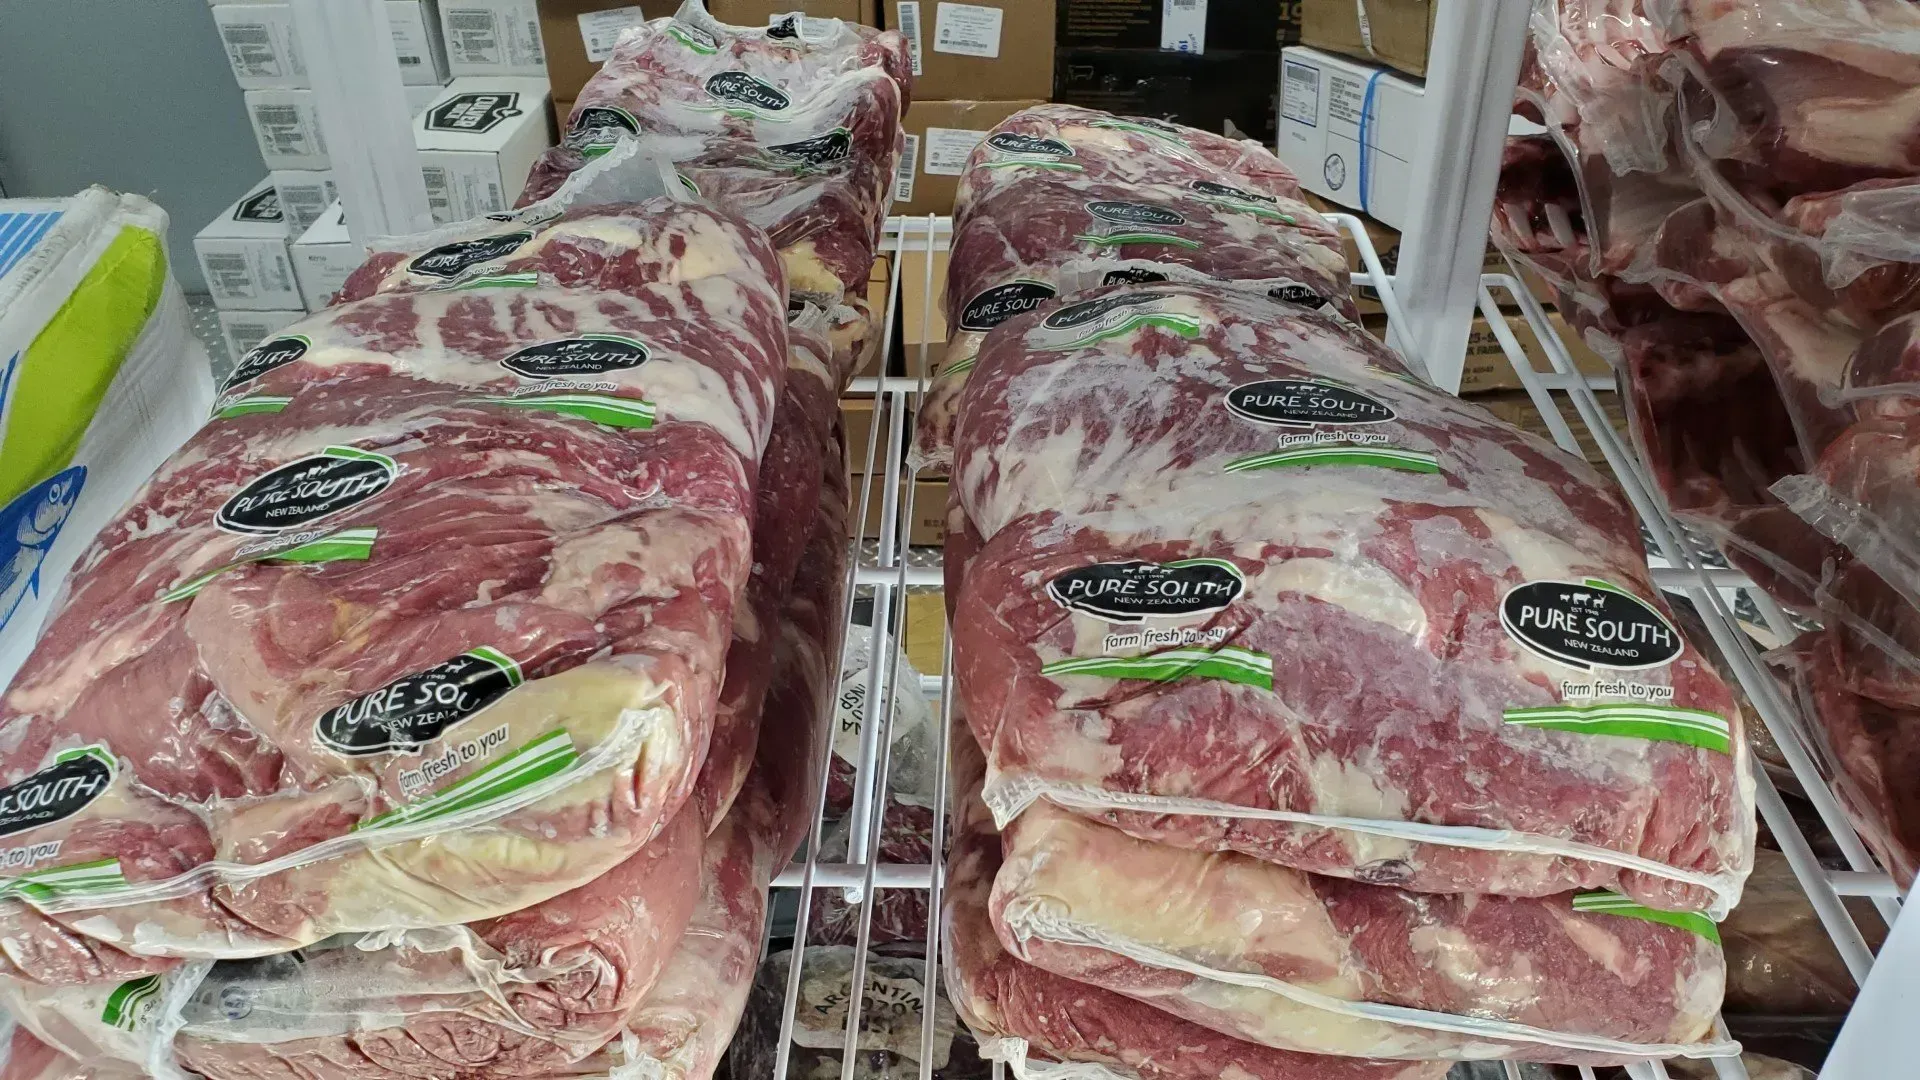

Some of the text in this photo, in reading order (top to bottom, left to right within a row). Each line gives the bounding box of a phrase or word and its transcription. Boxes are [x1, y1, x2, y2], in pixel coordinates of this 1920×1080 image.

[709, 79, 786, 108] PURE SOUTH
[992, 137, 1069, 156] PURE SOUTH
[1094, 205, 1129, 216] PURE
[1133, 209, 1182, 223] SOUTH
[966, 297, 1048, 323] PURE SOUT
[1105, 309, 1129, 327] fresh
[511, 351, 641, 365] PURE SOUTH
[512, 379, 617, 396] farm fresh to you
[1242, 394, 1388, 416] PURE SOUTH
[1312, 410, 1358, 419] ZEALAND
[1280, 431, 1386, 446] farm fresh to you
[229, 475, 386, 517] PURE SOUTH
[265, 503, 330, 519] NEW ZEALAND
[1067, 579, 1235, 597] PURE SOUTH
[1114, 596, 1201, 605] NEW ZEALAND
[1570, 606, 1584, 614] EST
[1519, 605, 1671, 648] PURE SOUTH
[1104, 634, 1139, 652] farm
[1143, 628, 1180, 647] fresh
[1184, 630, 1197, 643] to
[1563, 638, 1640, 659] NEW ZEALAND
[1562, 681, 1672, 700] farm fresh to you
[331, 681, 482, 733] PURE SOU
[380, 710, 459, 734] NEW ZEALA
[398, 726, 508, 794] farm fresh to you
[7, 774, 105, 814] SOUTH
[8, 843, 59, 865] to you
[815, 980, 924, 1016] ARGNTIN
